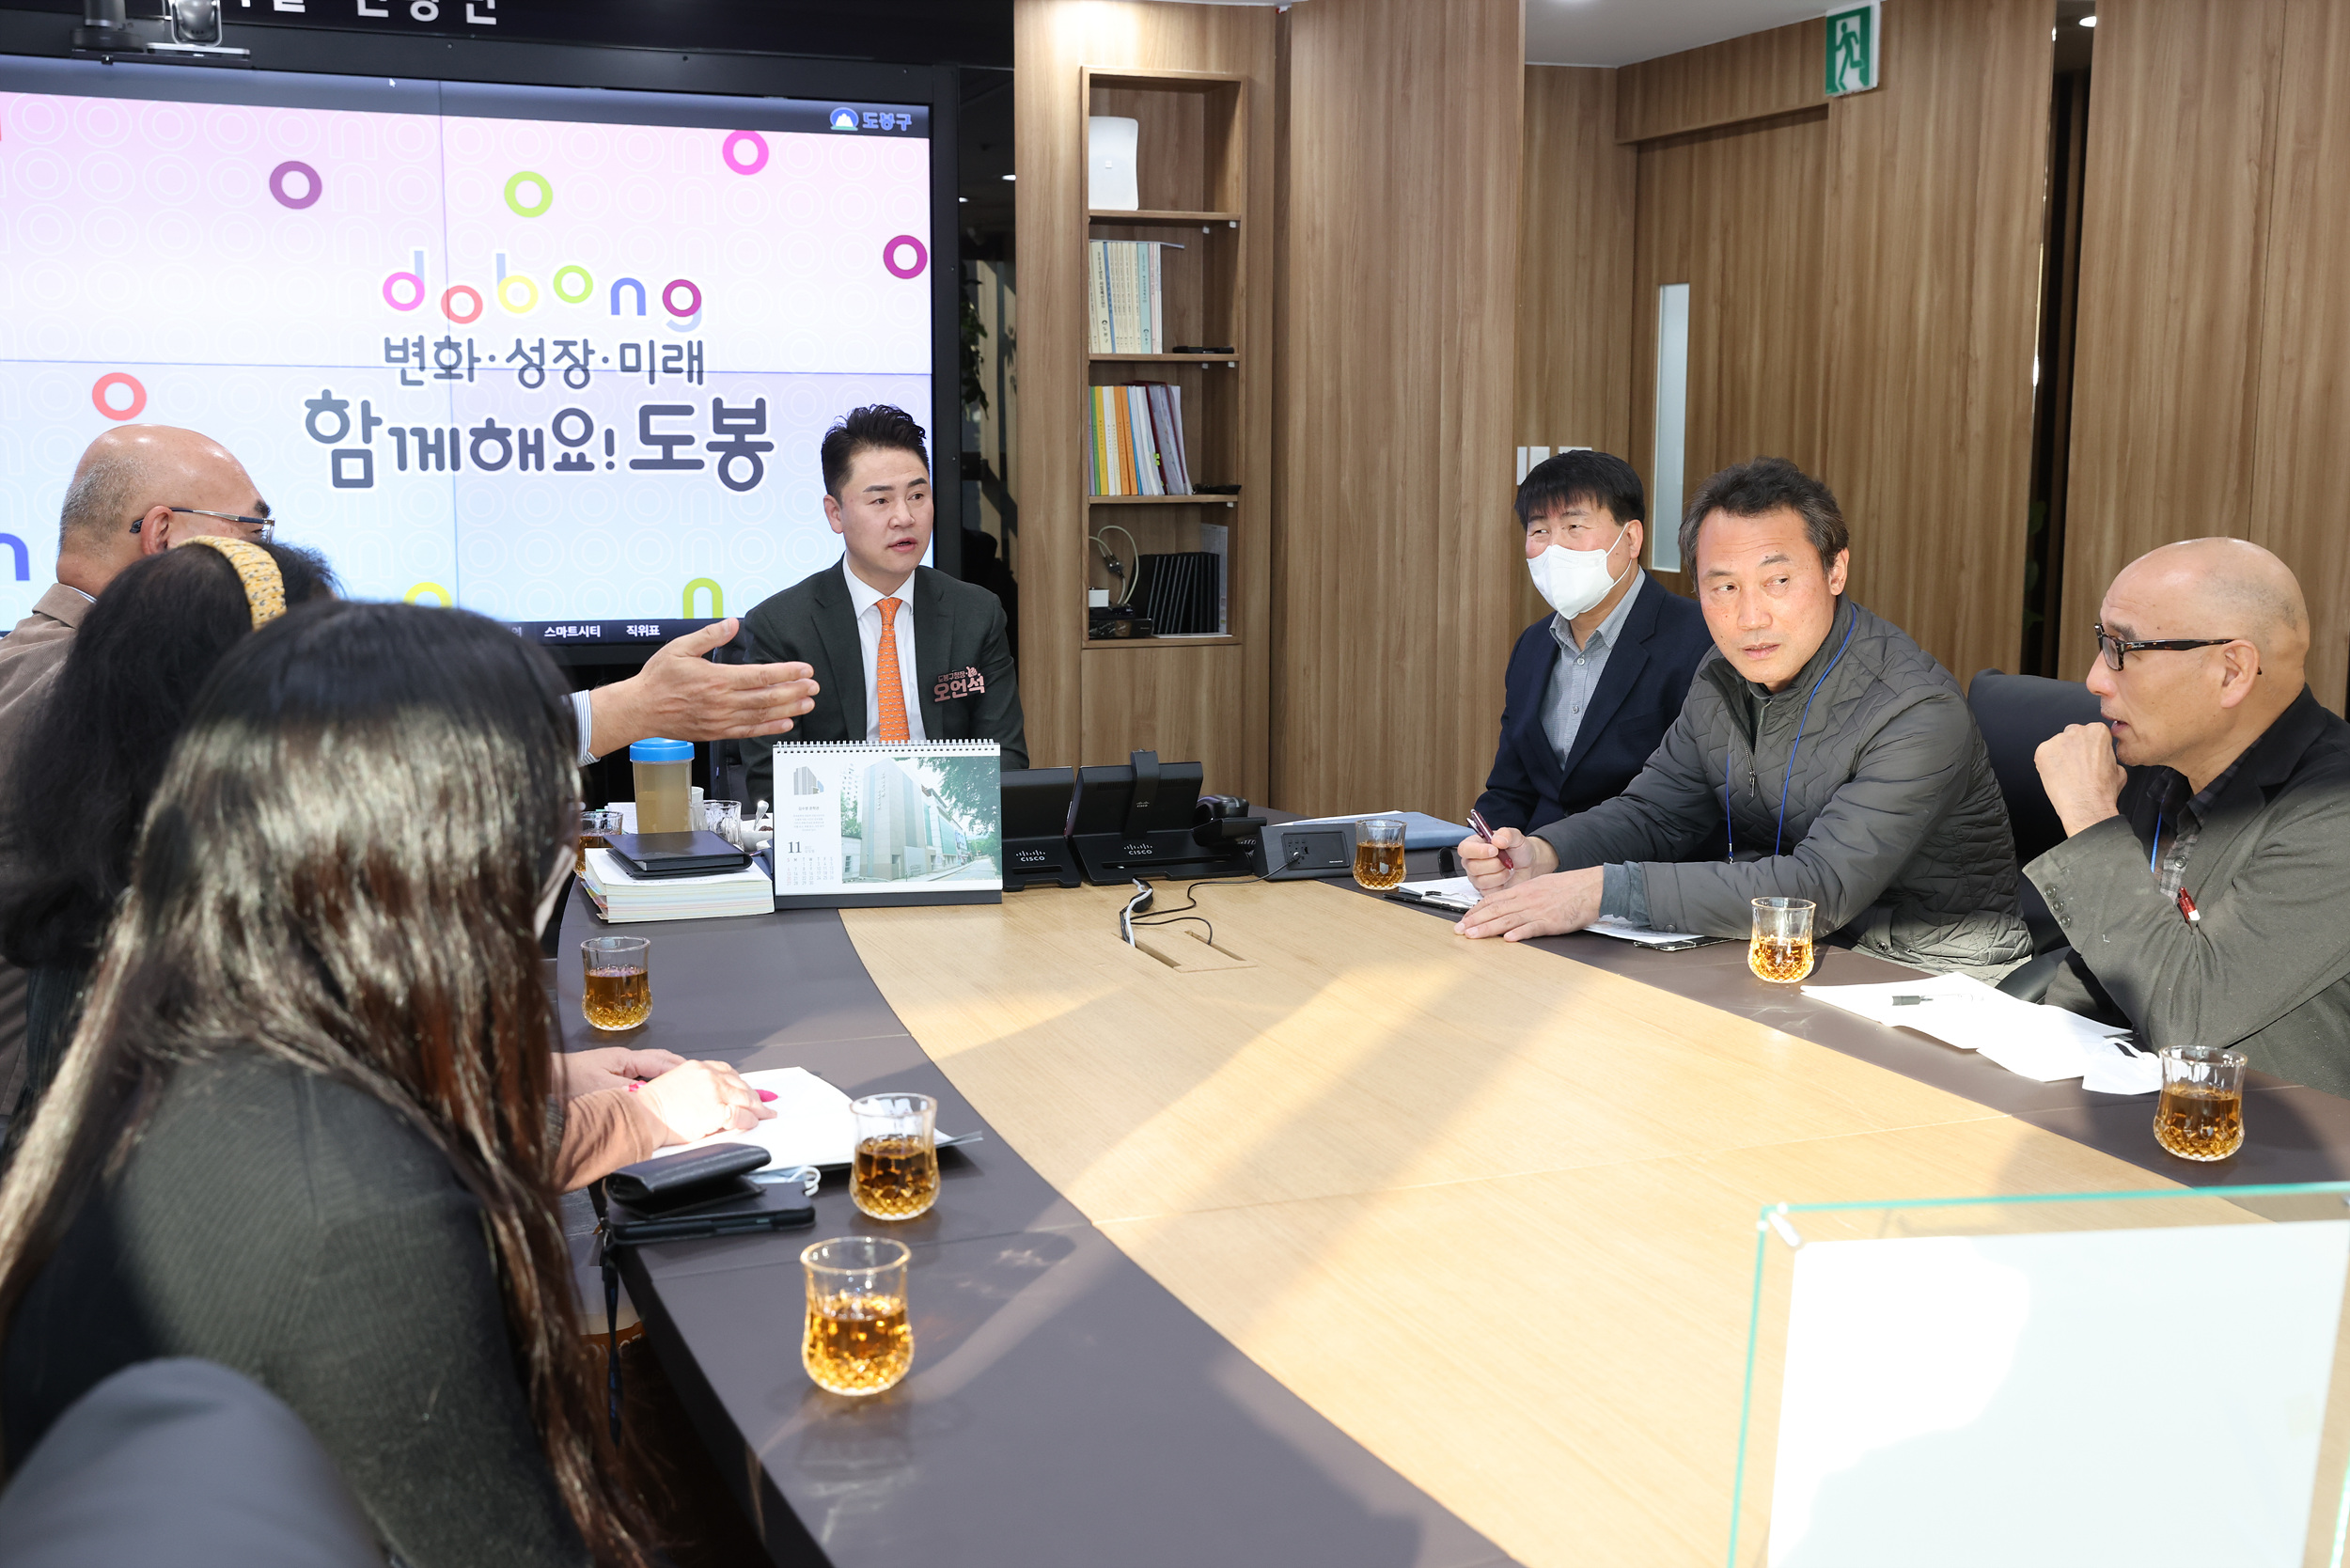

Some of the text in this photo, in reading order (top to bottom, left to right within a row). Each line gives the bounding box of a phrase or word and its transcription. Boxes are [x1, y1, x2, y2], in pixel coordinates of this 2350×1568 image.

[863, 112, 912, 131] 도봉구
[383, 250, 702, 332] dobong
[305, 389, 775, 492] 함께해요! 도봉
[544, 625, 601, 637] 스마트시티
[626, 625, 661, 636] 직위표
[933, 675, 985, 702] 오언석
[788, 841, 802, 854] 11
